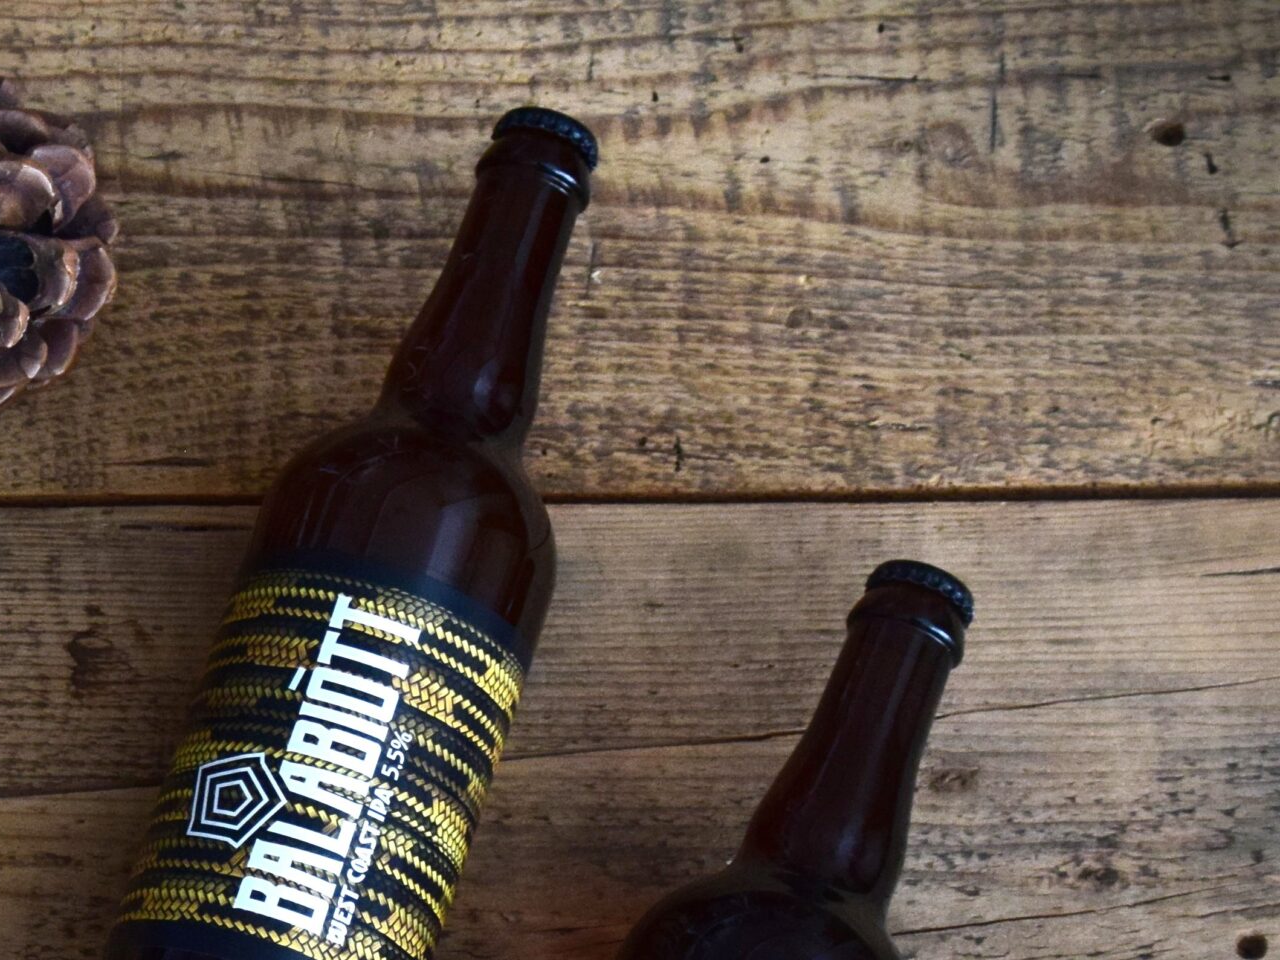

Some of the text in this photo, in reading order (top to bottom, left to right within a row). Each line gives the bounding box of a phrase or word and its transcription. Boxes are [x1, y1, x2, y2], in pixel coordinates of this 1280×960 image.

[325, 729, 414, 946] WEST COAST IPA 5.5%
